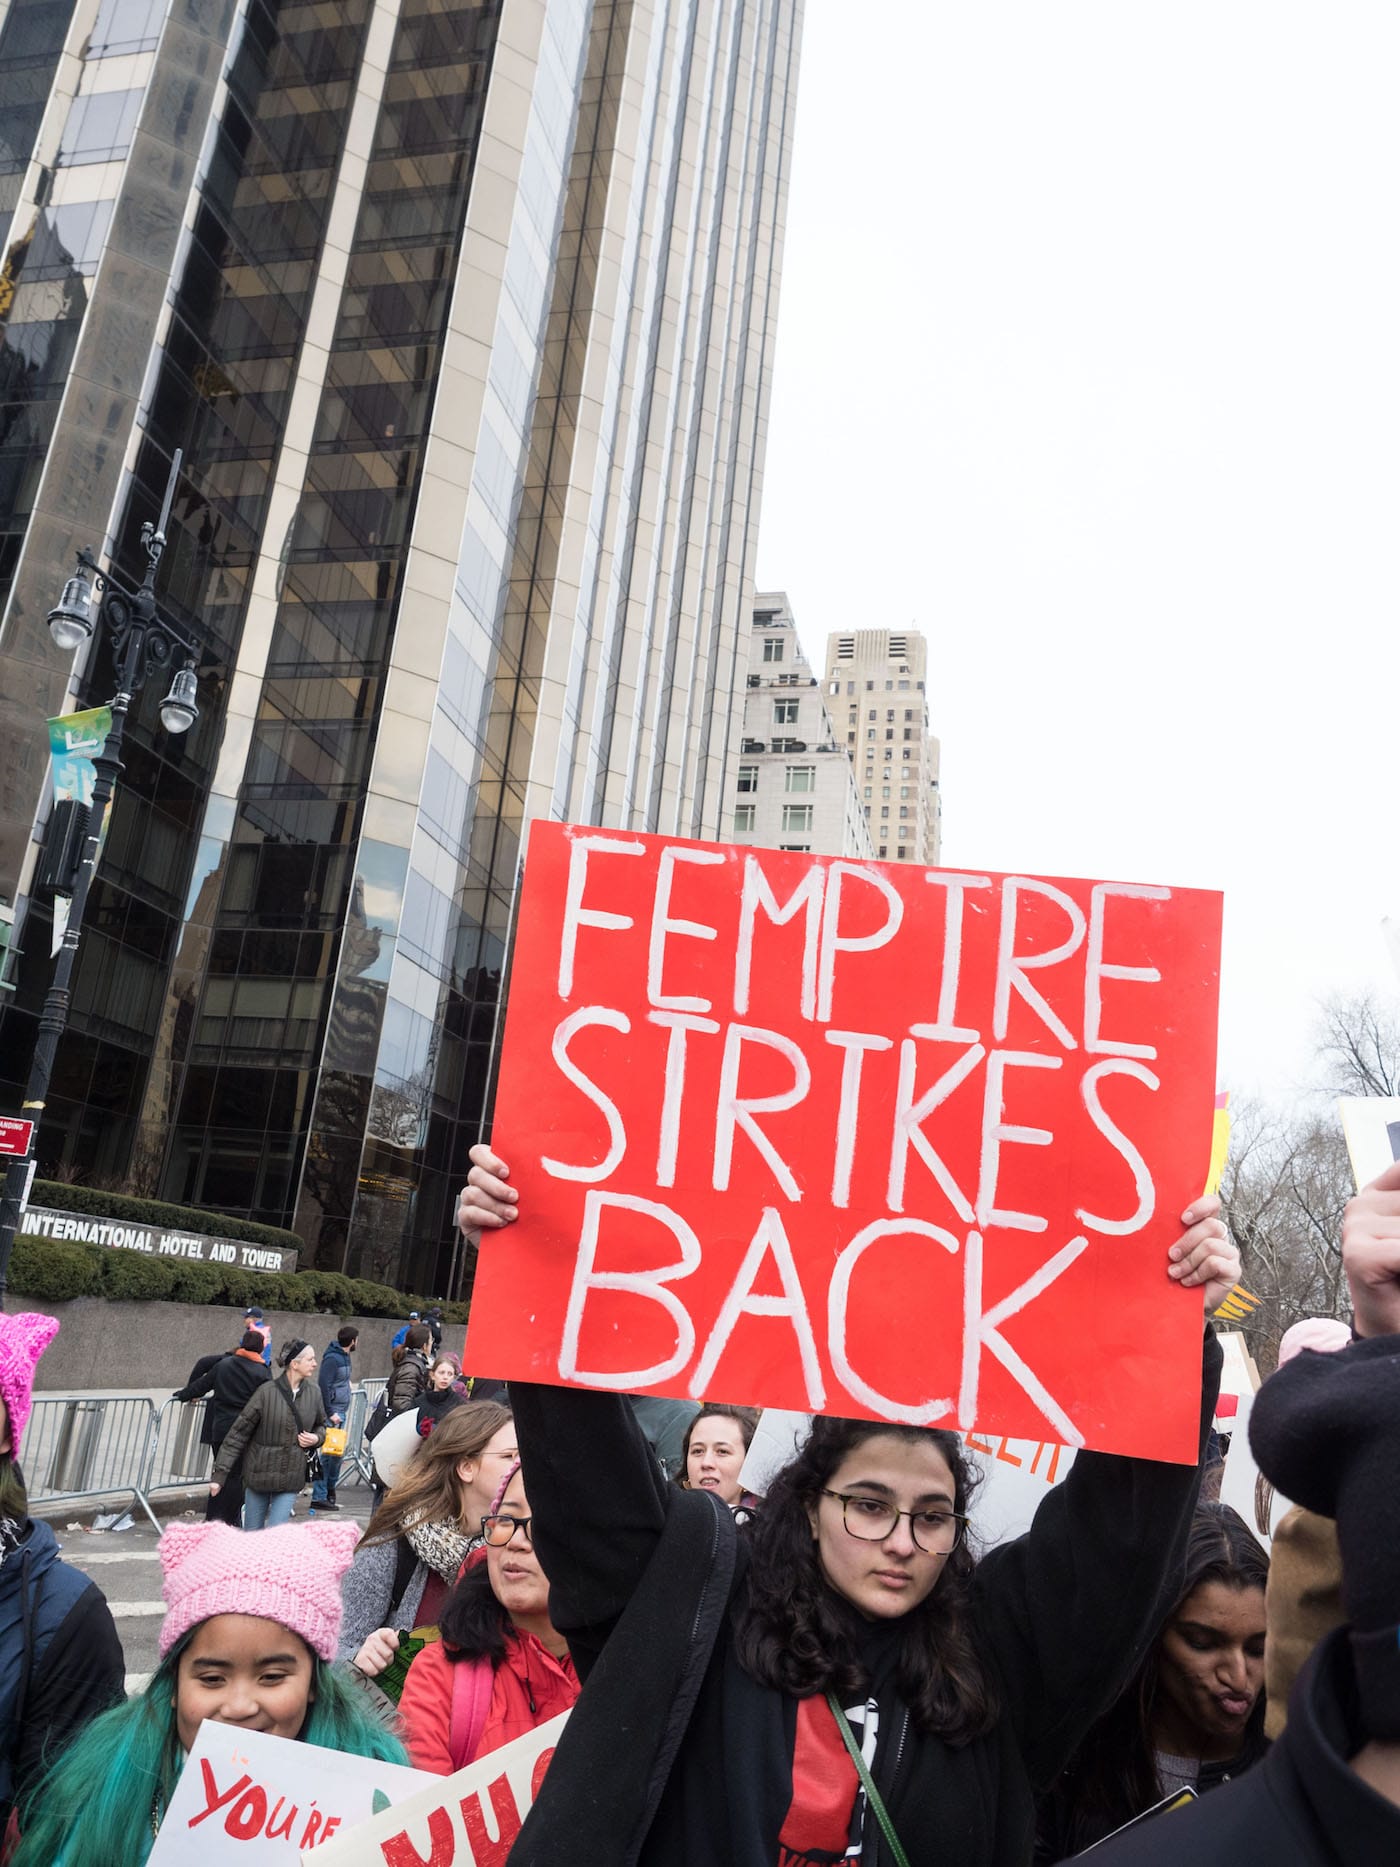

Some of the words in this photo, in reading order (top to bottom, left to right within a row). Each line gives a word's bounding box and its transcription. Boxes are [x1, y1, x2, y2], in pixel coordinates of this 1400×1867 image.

[558, 834, 1172, 1060] FEMPIRE
[541, 1005, 1161, 1237] STRIKES
[21, 1212, 153, 1252] INTERNATIONAL
[159, 1234, 204, 1259] HOTEL
[209, 1243, 236, 1263] AND
[241, 1247, 283, 1270] TOWER
[558, 1189, 1089, 1447] BACK
